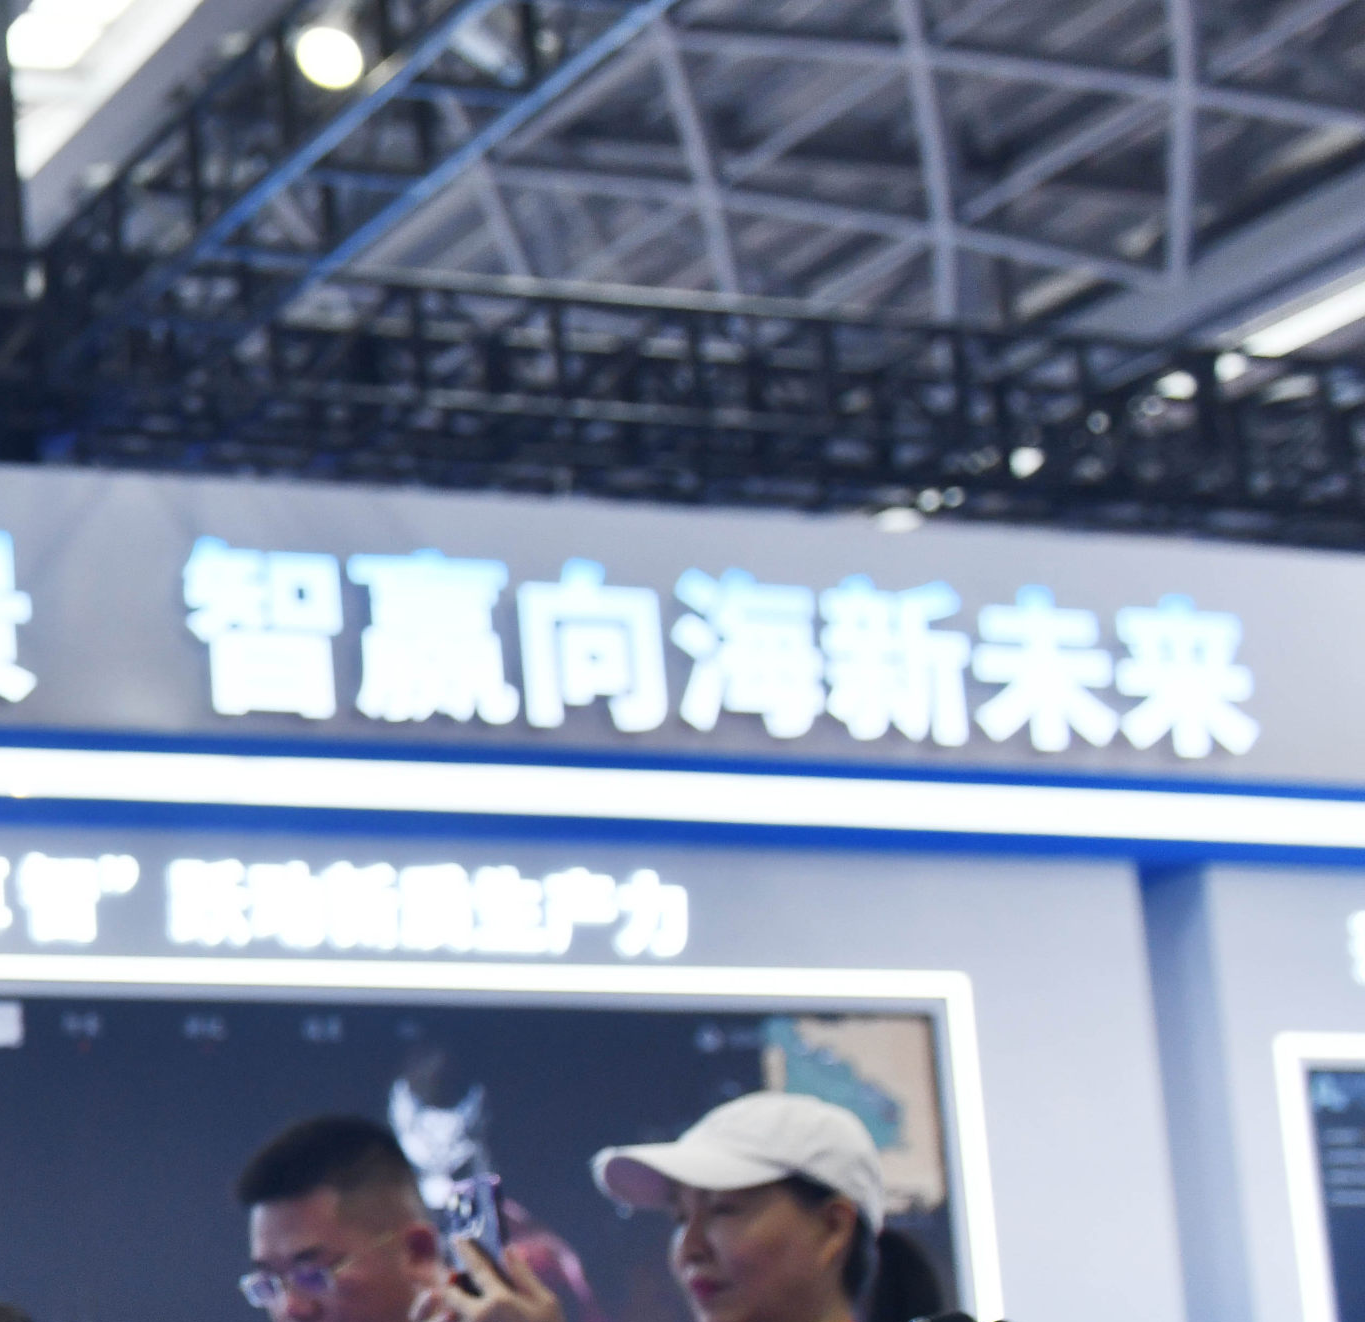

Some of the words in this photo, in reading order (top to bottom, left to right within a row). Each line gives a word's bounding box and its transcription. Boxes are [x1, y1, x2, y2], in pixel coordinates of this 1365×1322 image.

[182, 536, 1257, 758] 智赢向海新未来
